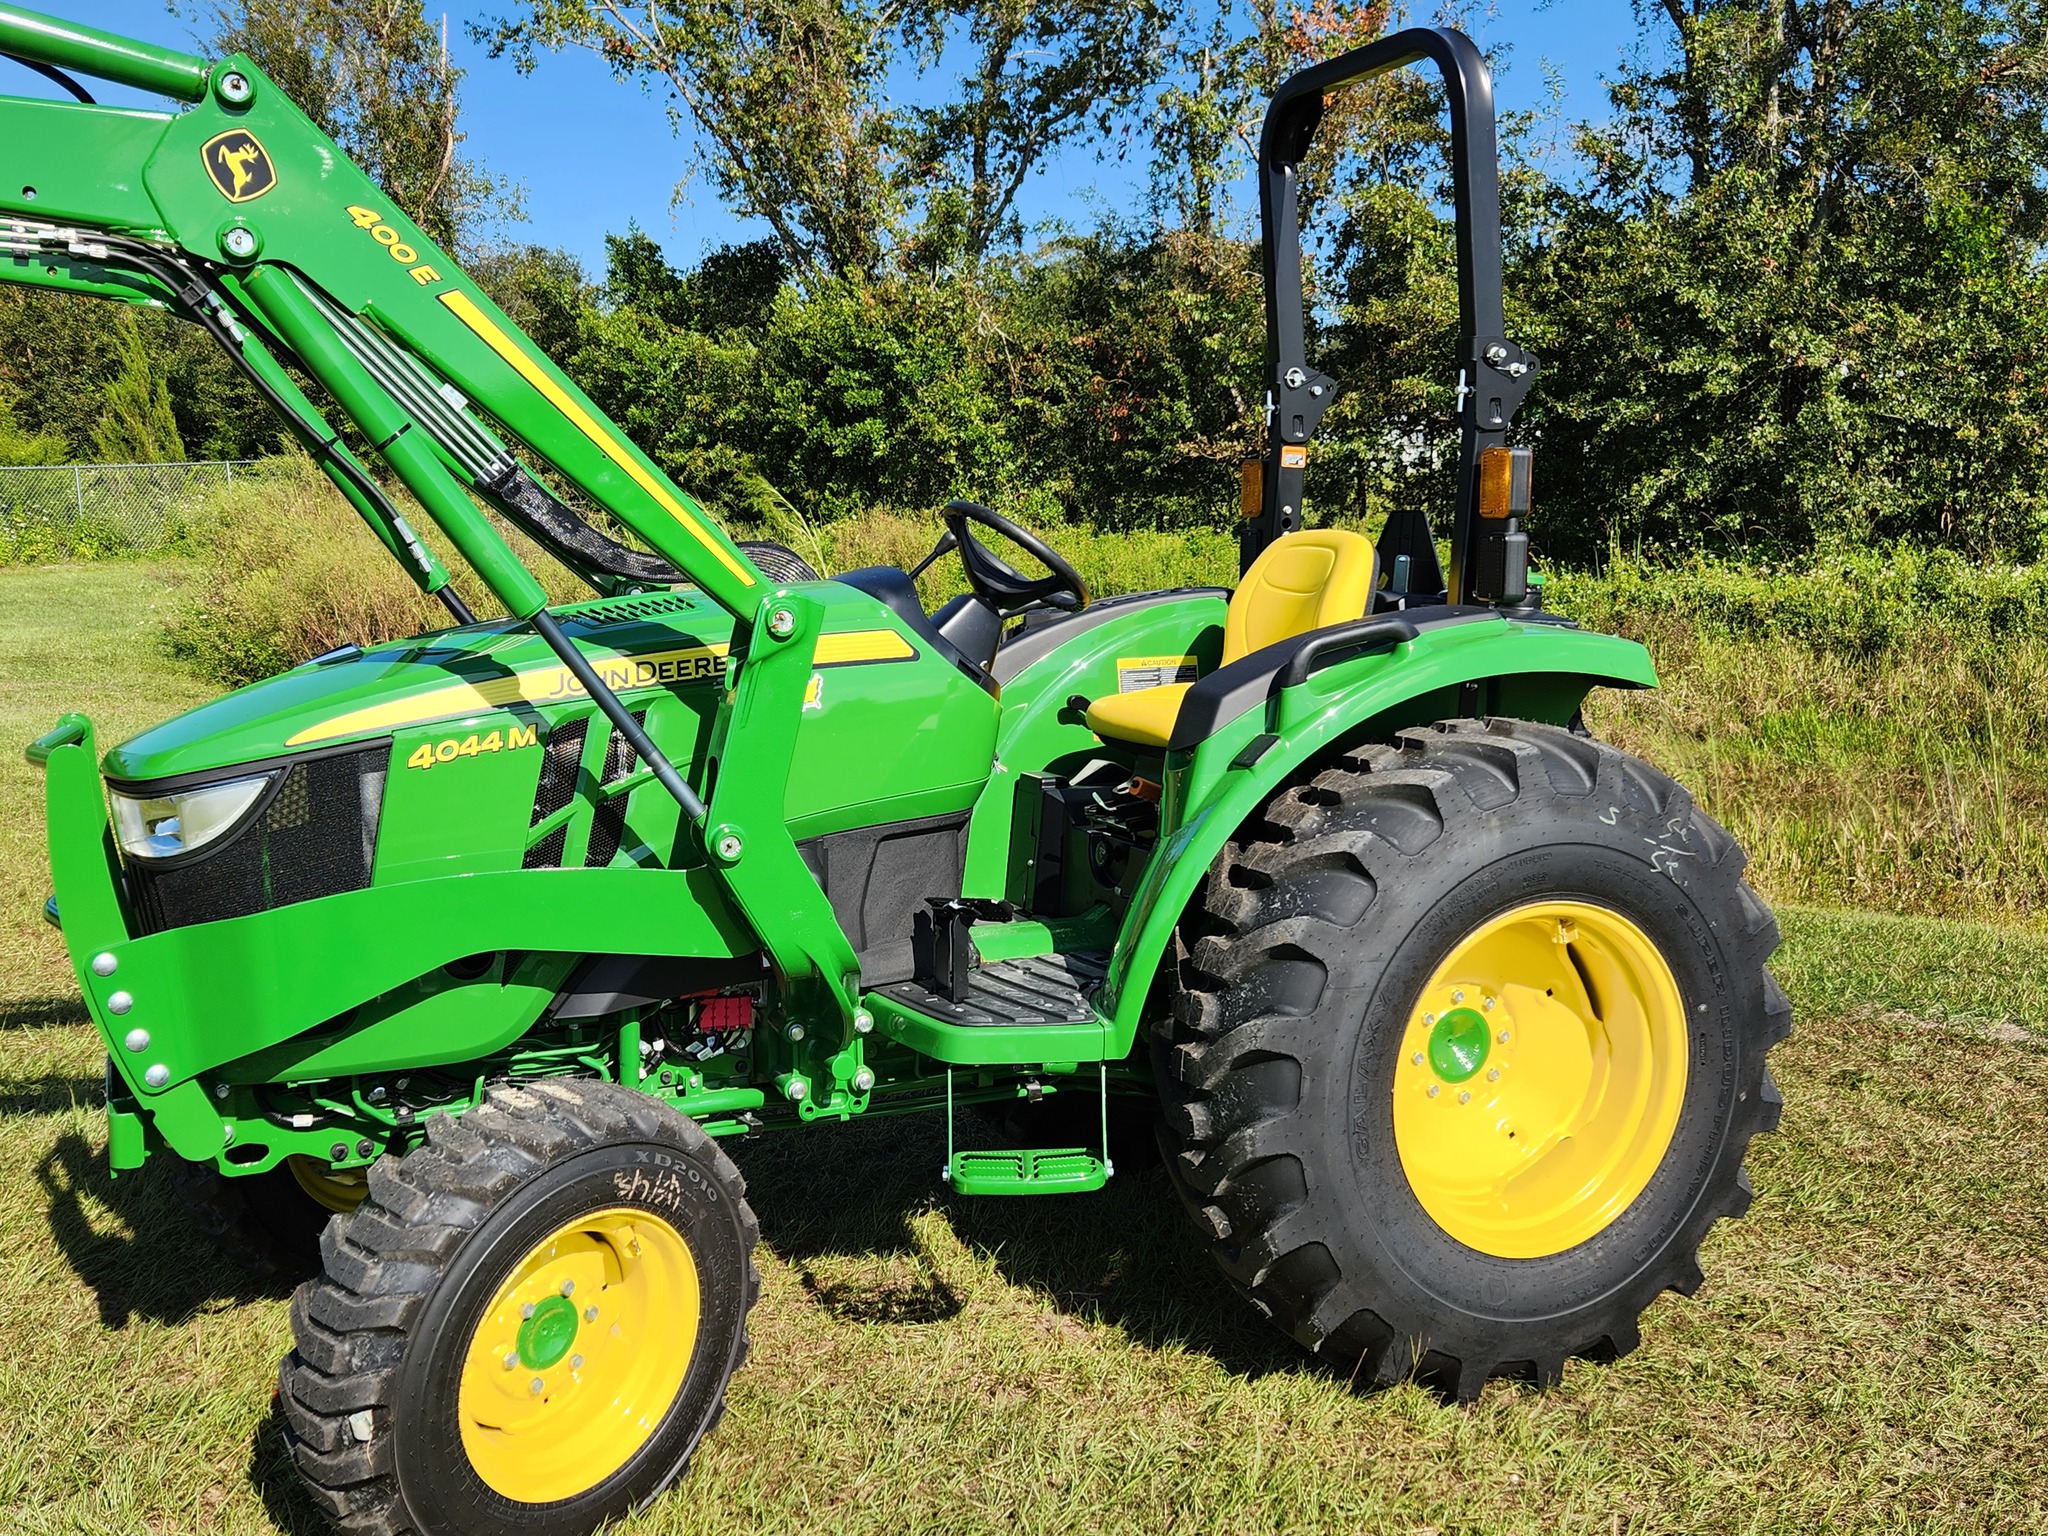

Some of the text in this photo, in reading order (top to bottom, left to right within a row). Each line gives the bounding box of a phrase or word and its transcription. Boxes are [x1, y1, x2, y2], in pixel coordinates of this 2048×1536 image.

[344, 205, 443, 286] 400 E
[635, 655, 727, 683] DEERE
[407, 723, 538, 769] 4044 M
[1674, 902, 1727, 998] SUPER
[1353, 991, 1390, 1162] GALAXY
